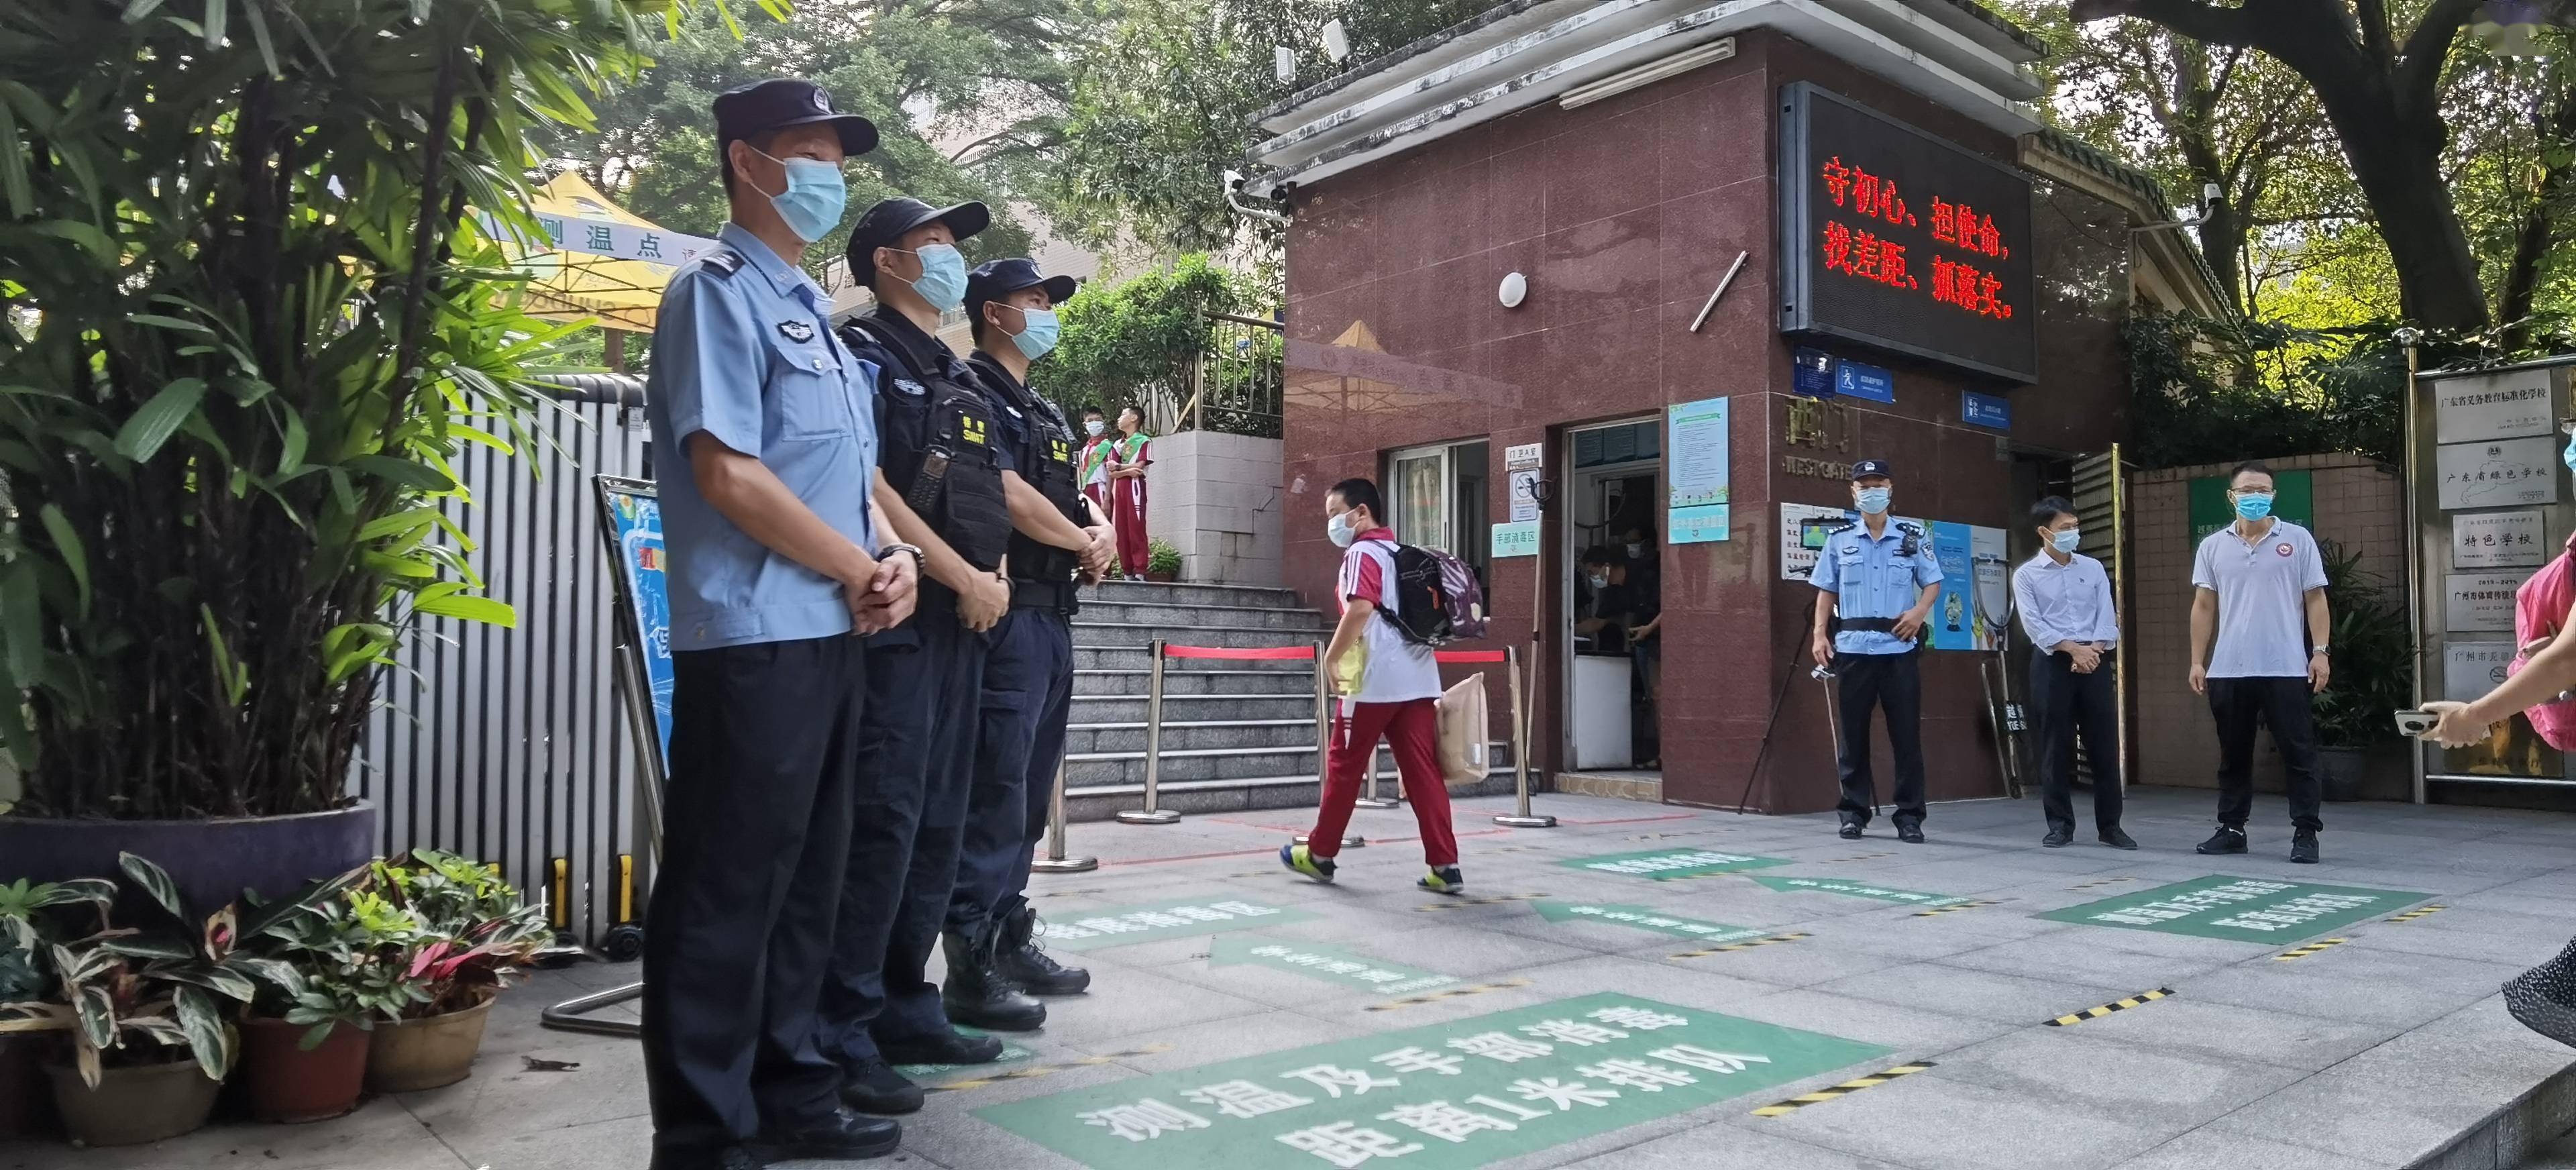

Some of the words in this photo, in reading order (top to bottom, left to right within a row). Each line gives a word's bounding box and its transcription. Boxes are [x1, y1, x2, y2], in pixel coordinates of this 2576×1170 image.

[539, 216, 662, 259] 测温点
[2441, 387, 2546, 408] 广东省义务教育标准化学校
[1785, 456, 1819, 476] WEST
[1819, 461, 1853, 481] GATE
[2447, 468, 2547, 483] 广东省绿色学校
[1496, 531, 1535, 545] 手部消毒区
[2464, 533, 2533, 547] 特色学校
[2210, 892, 2380, 931] 距离1米排队
[1075, 1004, 1689, 1142] 测温及手部消毒
[1274, 1044, 1772, 1170] 距离1米排队
